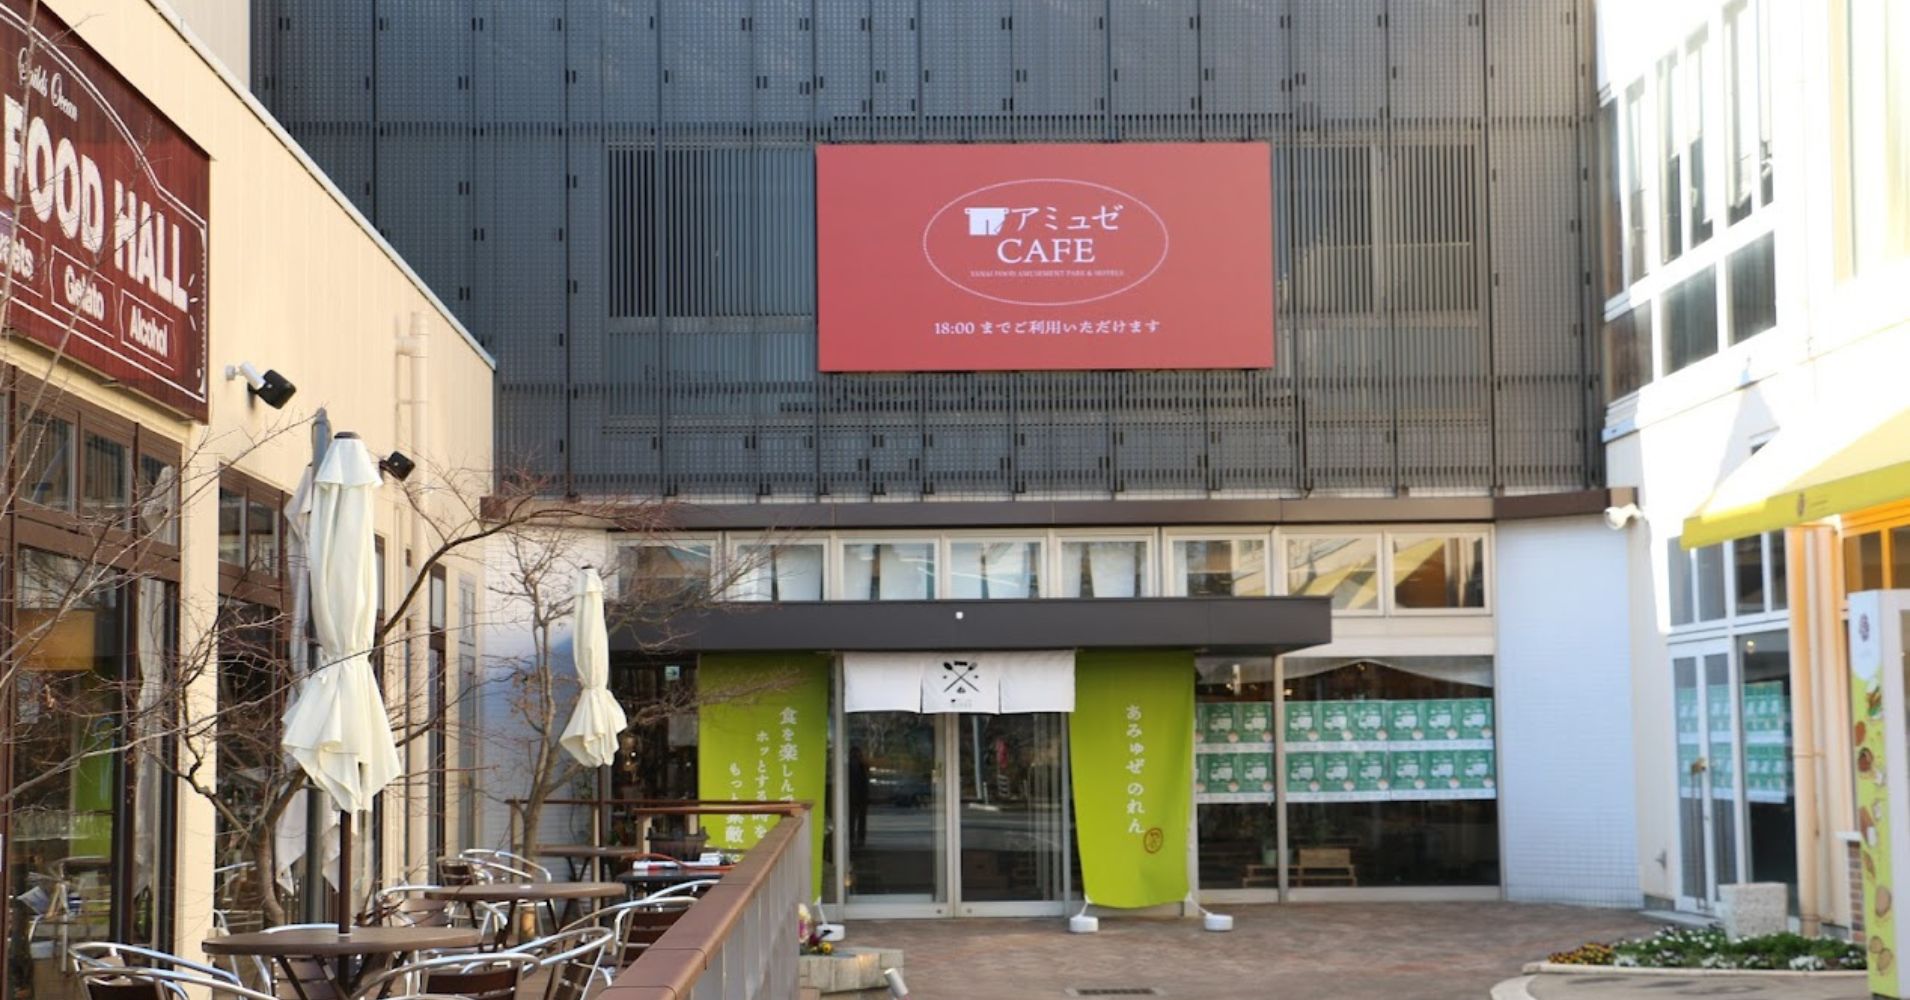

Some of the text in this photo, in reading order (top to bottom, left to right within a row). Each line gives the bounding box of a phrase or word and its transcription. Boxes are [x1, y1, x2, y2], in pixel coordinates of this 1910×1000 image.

[4, 94, 189, 314] FOOD HALL
[1011, 204, 1124, 231] アミュゼ
[997, 238, 1096, 264] CAFE
[64, 264, 105, 321] Gelato
[129, 304, 168, 358] Alcohol
[934, 319, 1160, 335] 18:00 までご利用いただけます
